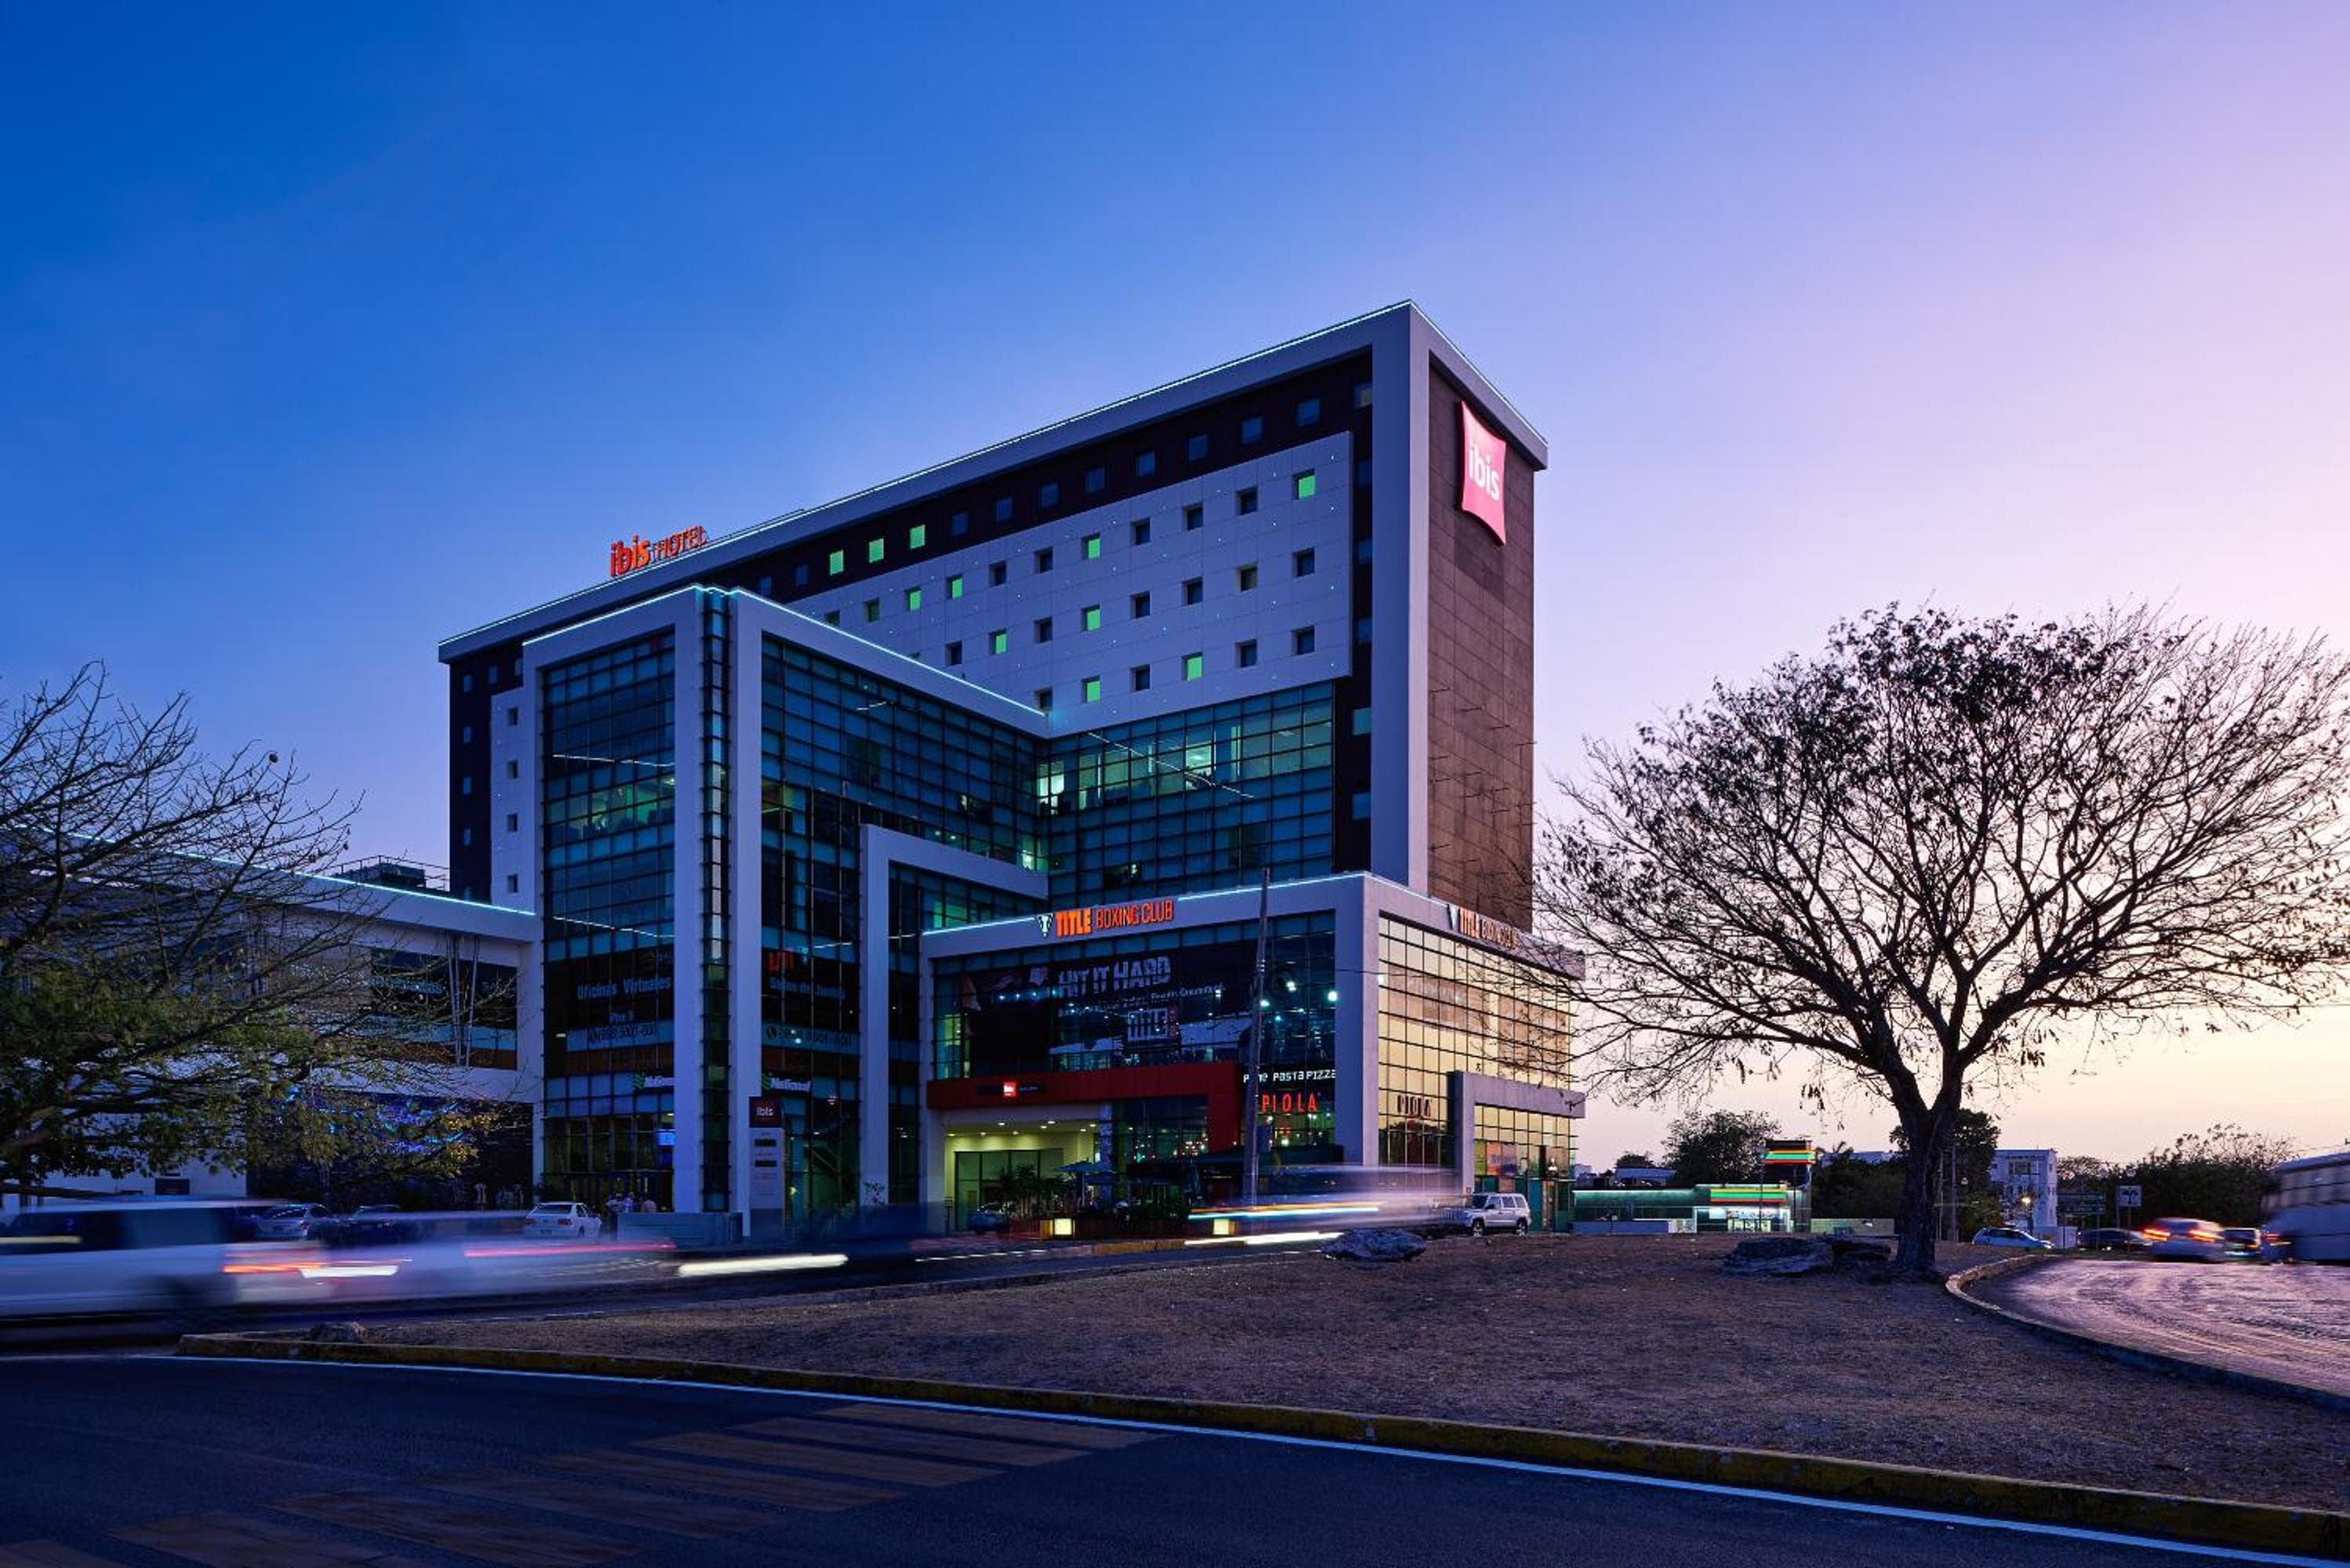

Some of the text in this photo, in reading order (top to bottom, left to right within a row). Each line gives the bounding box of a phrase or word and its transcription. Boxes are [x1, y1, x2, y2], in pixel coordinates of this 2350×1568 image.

[1469, 439, 1500, 501] ibis
[610, 525, 705, 578] ibis HOTEL
[1055, 899, 1175, 938] TITLE BOXING CLUB
[1059, 954, 1172, 998] HIT IT HARD
[756, 1106, 773, 1116] ibis
[1262, 1091, 1317, 1114] PIOLA
